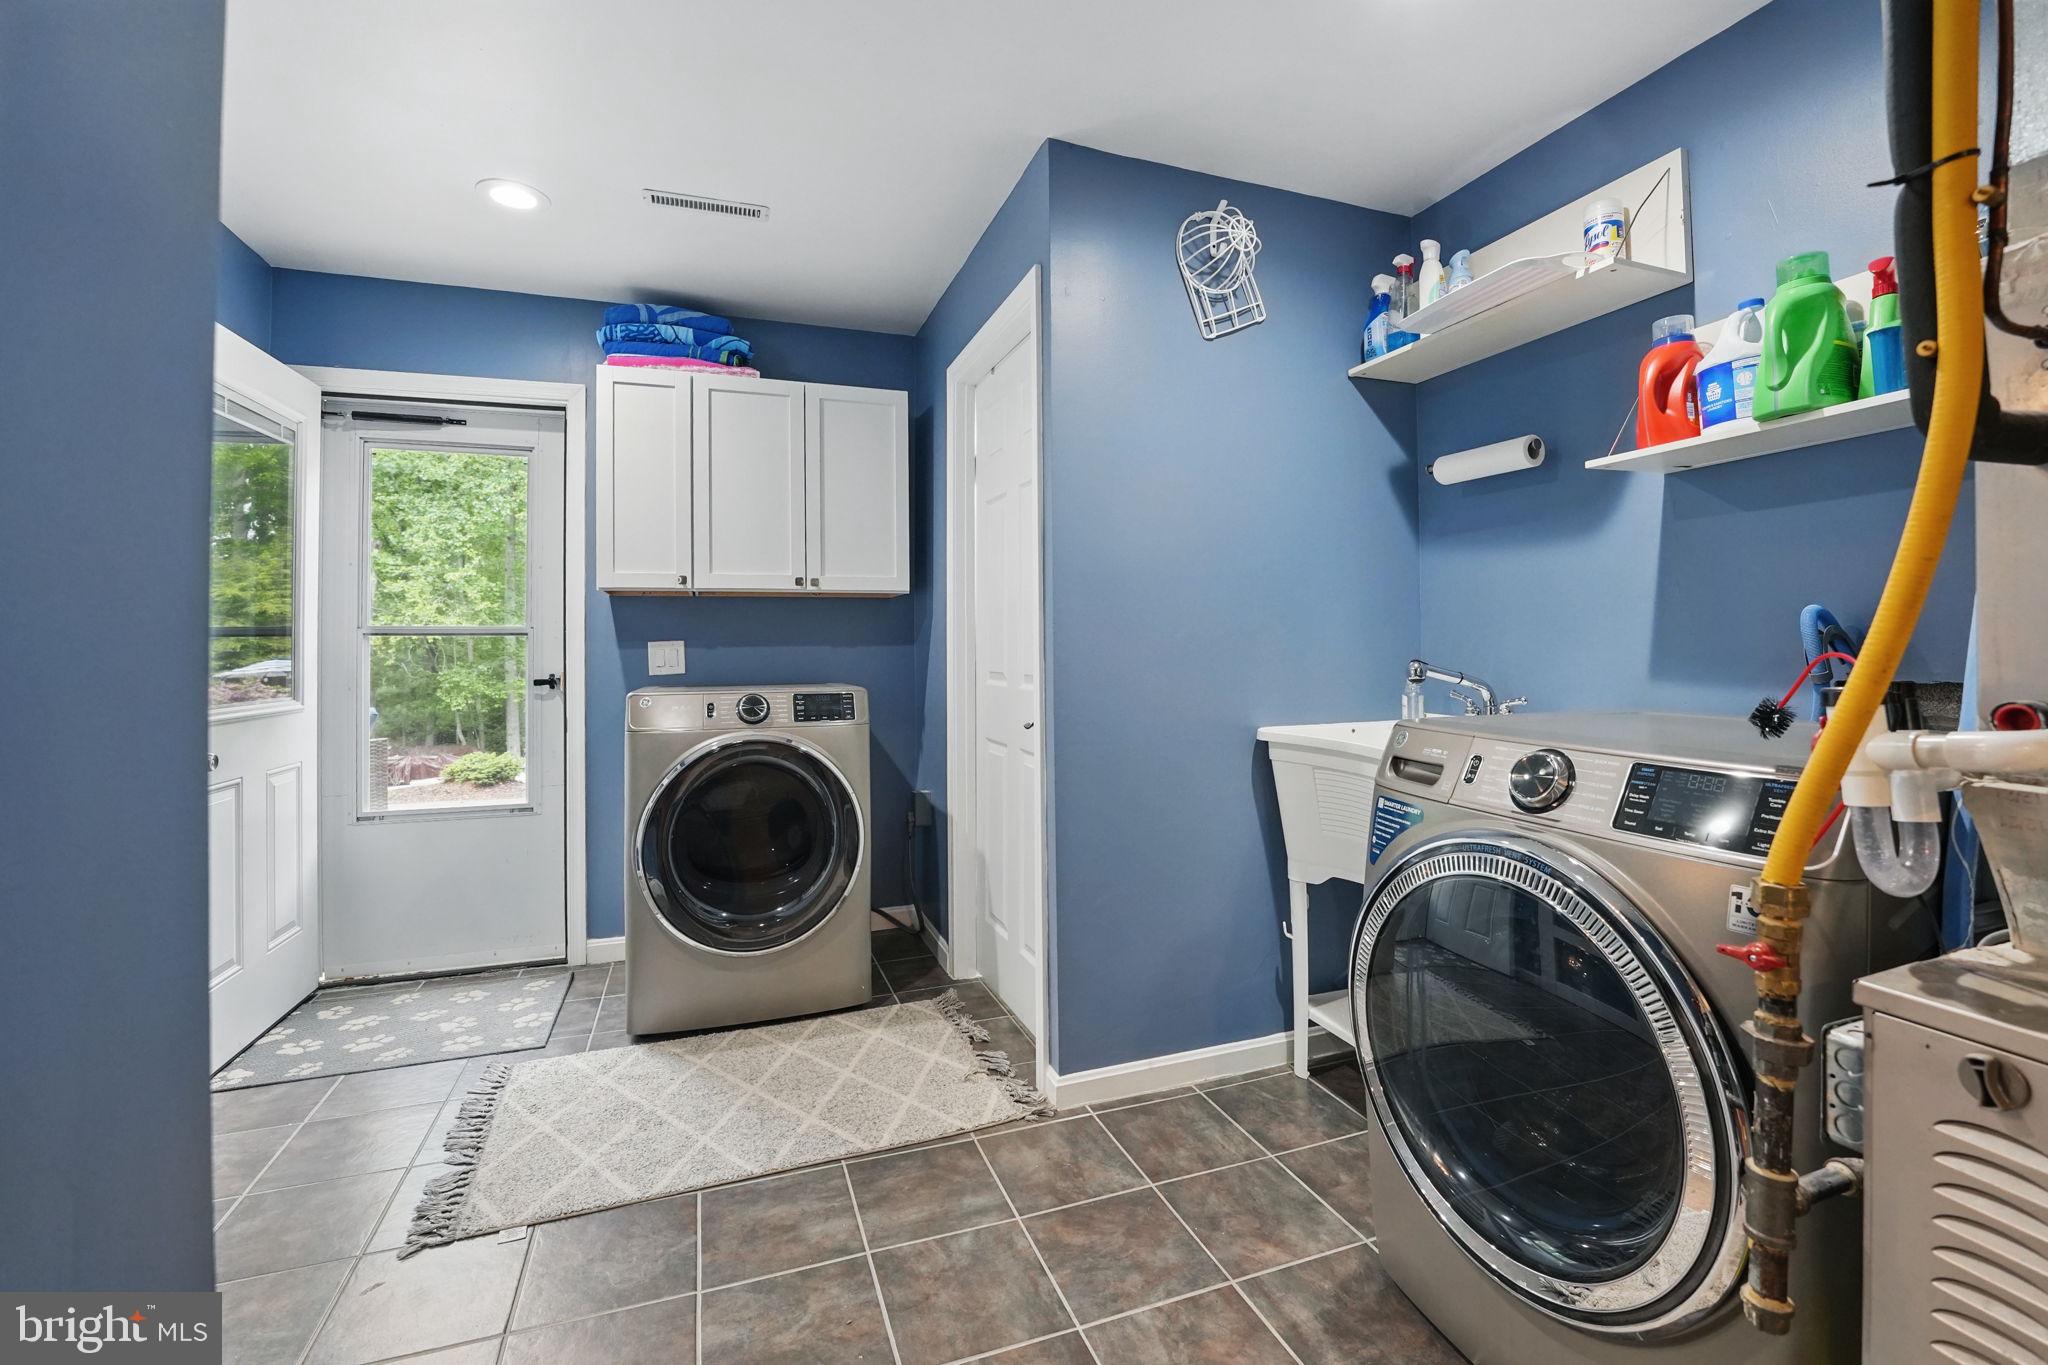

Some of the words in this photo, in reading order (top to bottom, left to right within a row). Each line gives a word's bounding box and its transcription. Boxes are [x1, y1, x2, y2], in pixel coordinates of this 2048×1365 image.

[1462, 844, 1501, 855] ULTRAFRESH
[1504, 848, 1521, 860] VENT
[1524, 856, 1553, 874] SYSTEM
